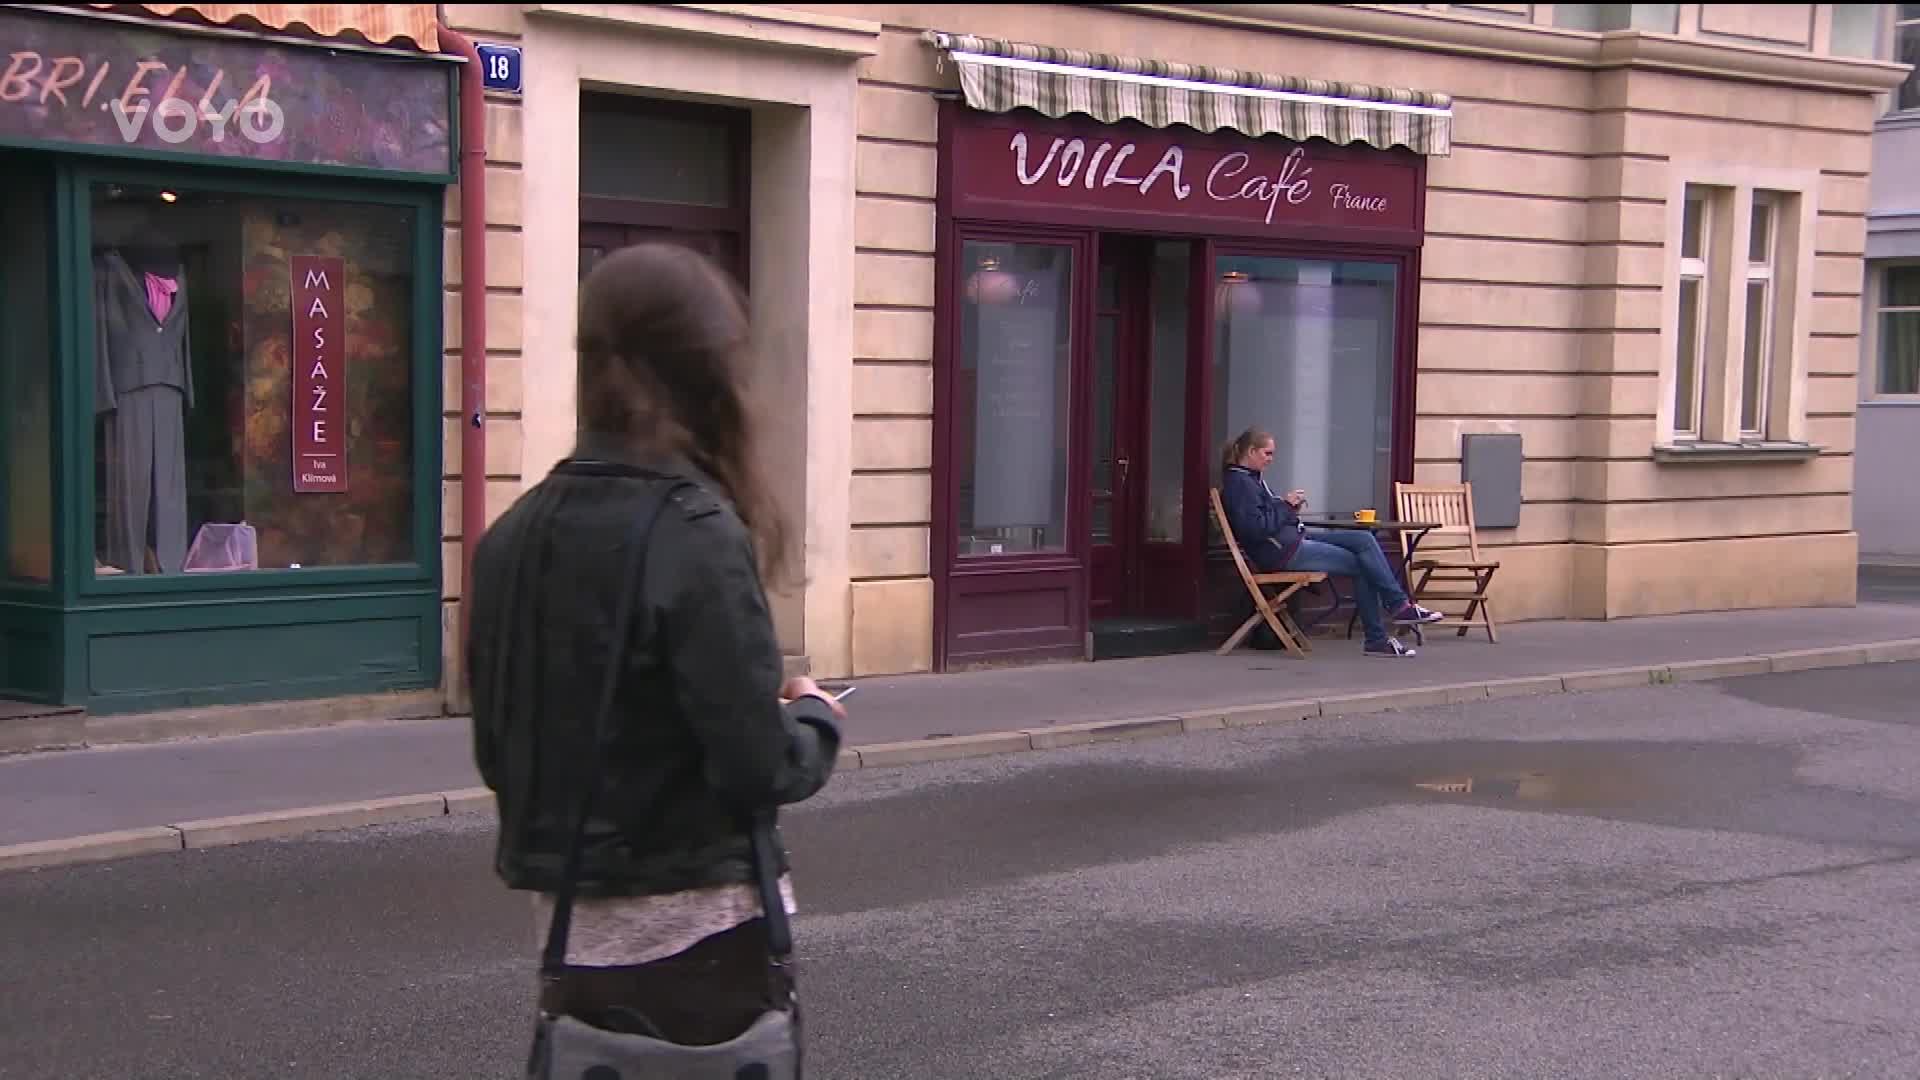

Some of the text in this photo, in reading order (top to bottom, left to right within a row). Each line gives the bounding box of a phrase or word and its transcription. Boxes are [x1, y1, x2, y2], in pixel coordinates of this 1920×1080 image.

[490, 55, 509, 80] 18
[1010, 131, 1387, 225] VOILA Café France
[305, 269, 330, 443] MASÁŽE
[313, 459, 327, 469] Iva
